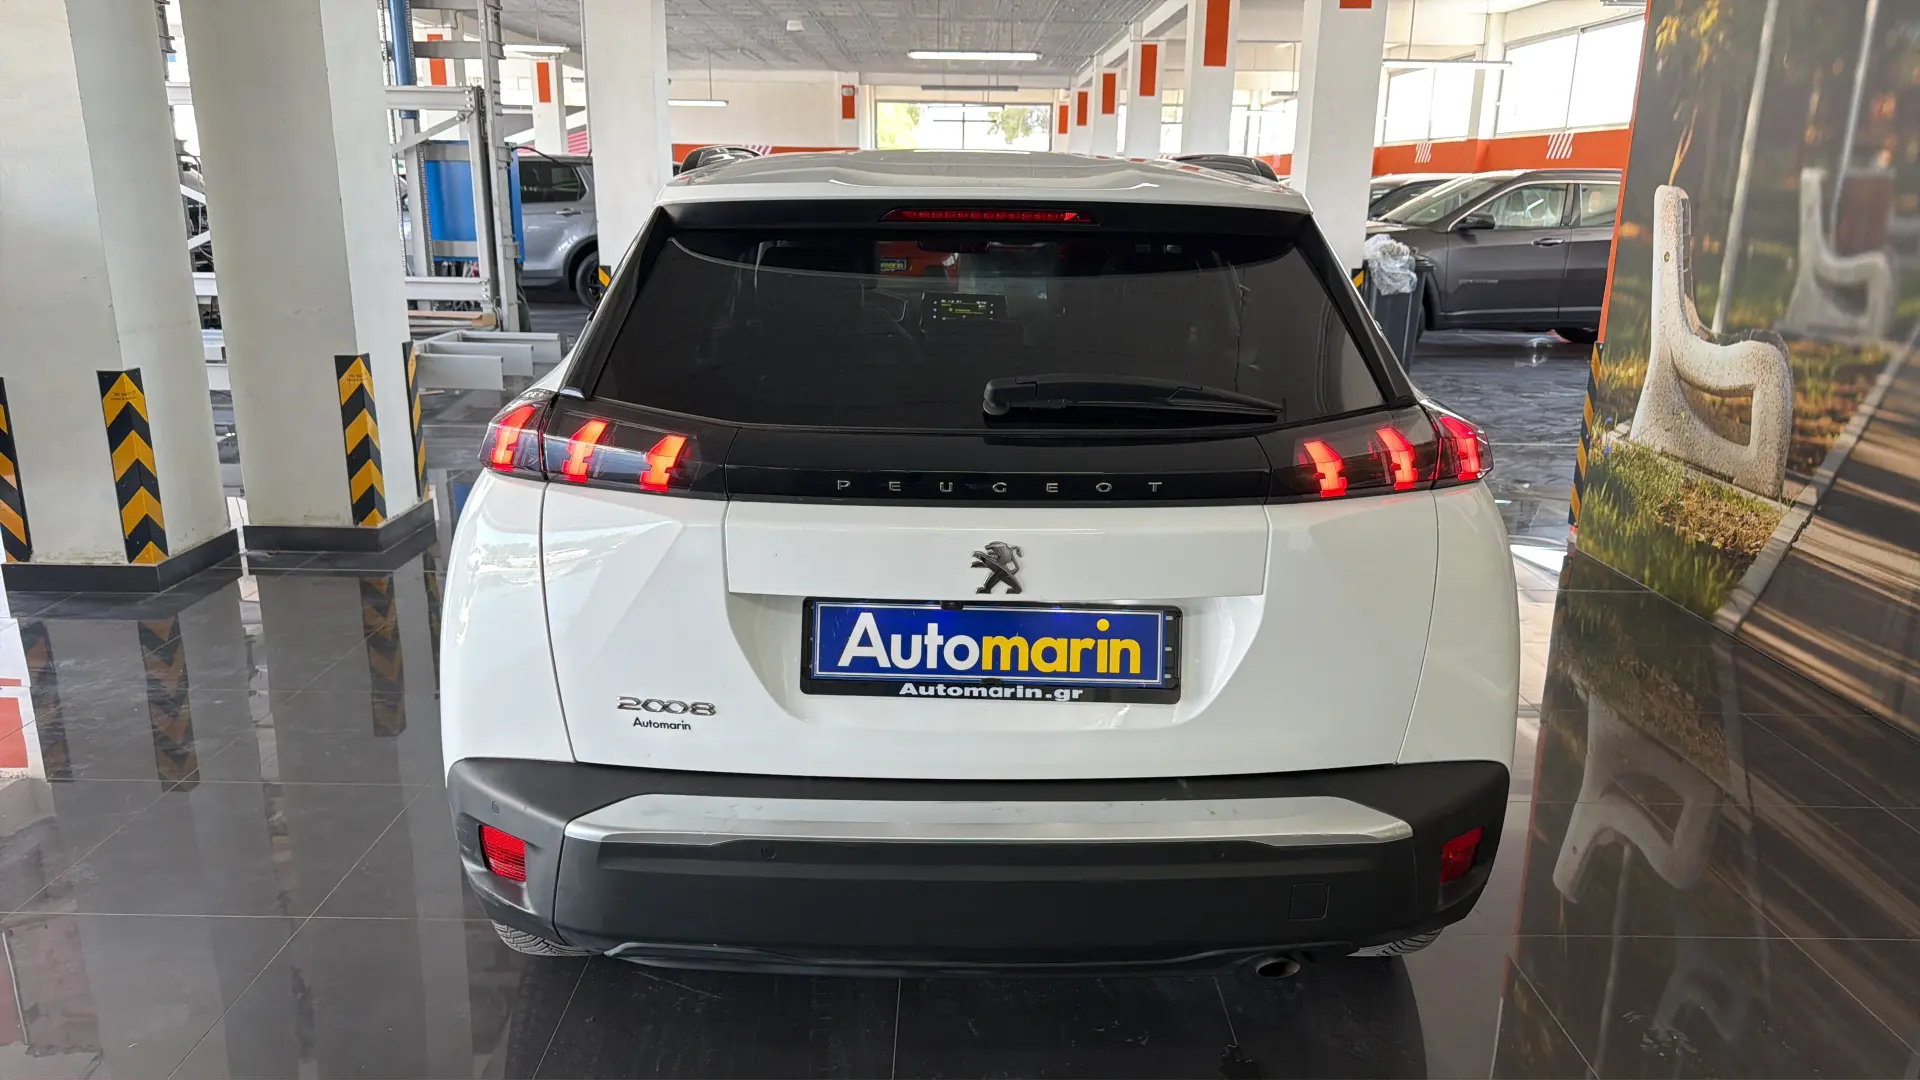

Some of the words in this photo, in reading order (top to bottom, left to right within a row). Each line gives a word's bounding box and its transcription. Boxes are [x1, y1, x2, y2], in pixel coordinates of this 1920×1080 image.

[836, 479, 1163, 493] PEUGEOT
[837, 612, 1141, 674] Automarin
[899, 681, 1084, 701] Automarin.gr
[616, 696, 716, 716] 2008
[632, 717, 692, 730] Automarin
